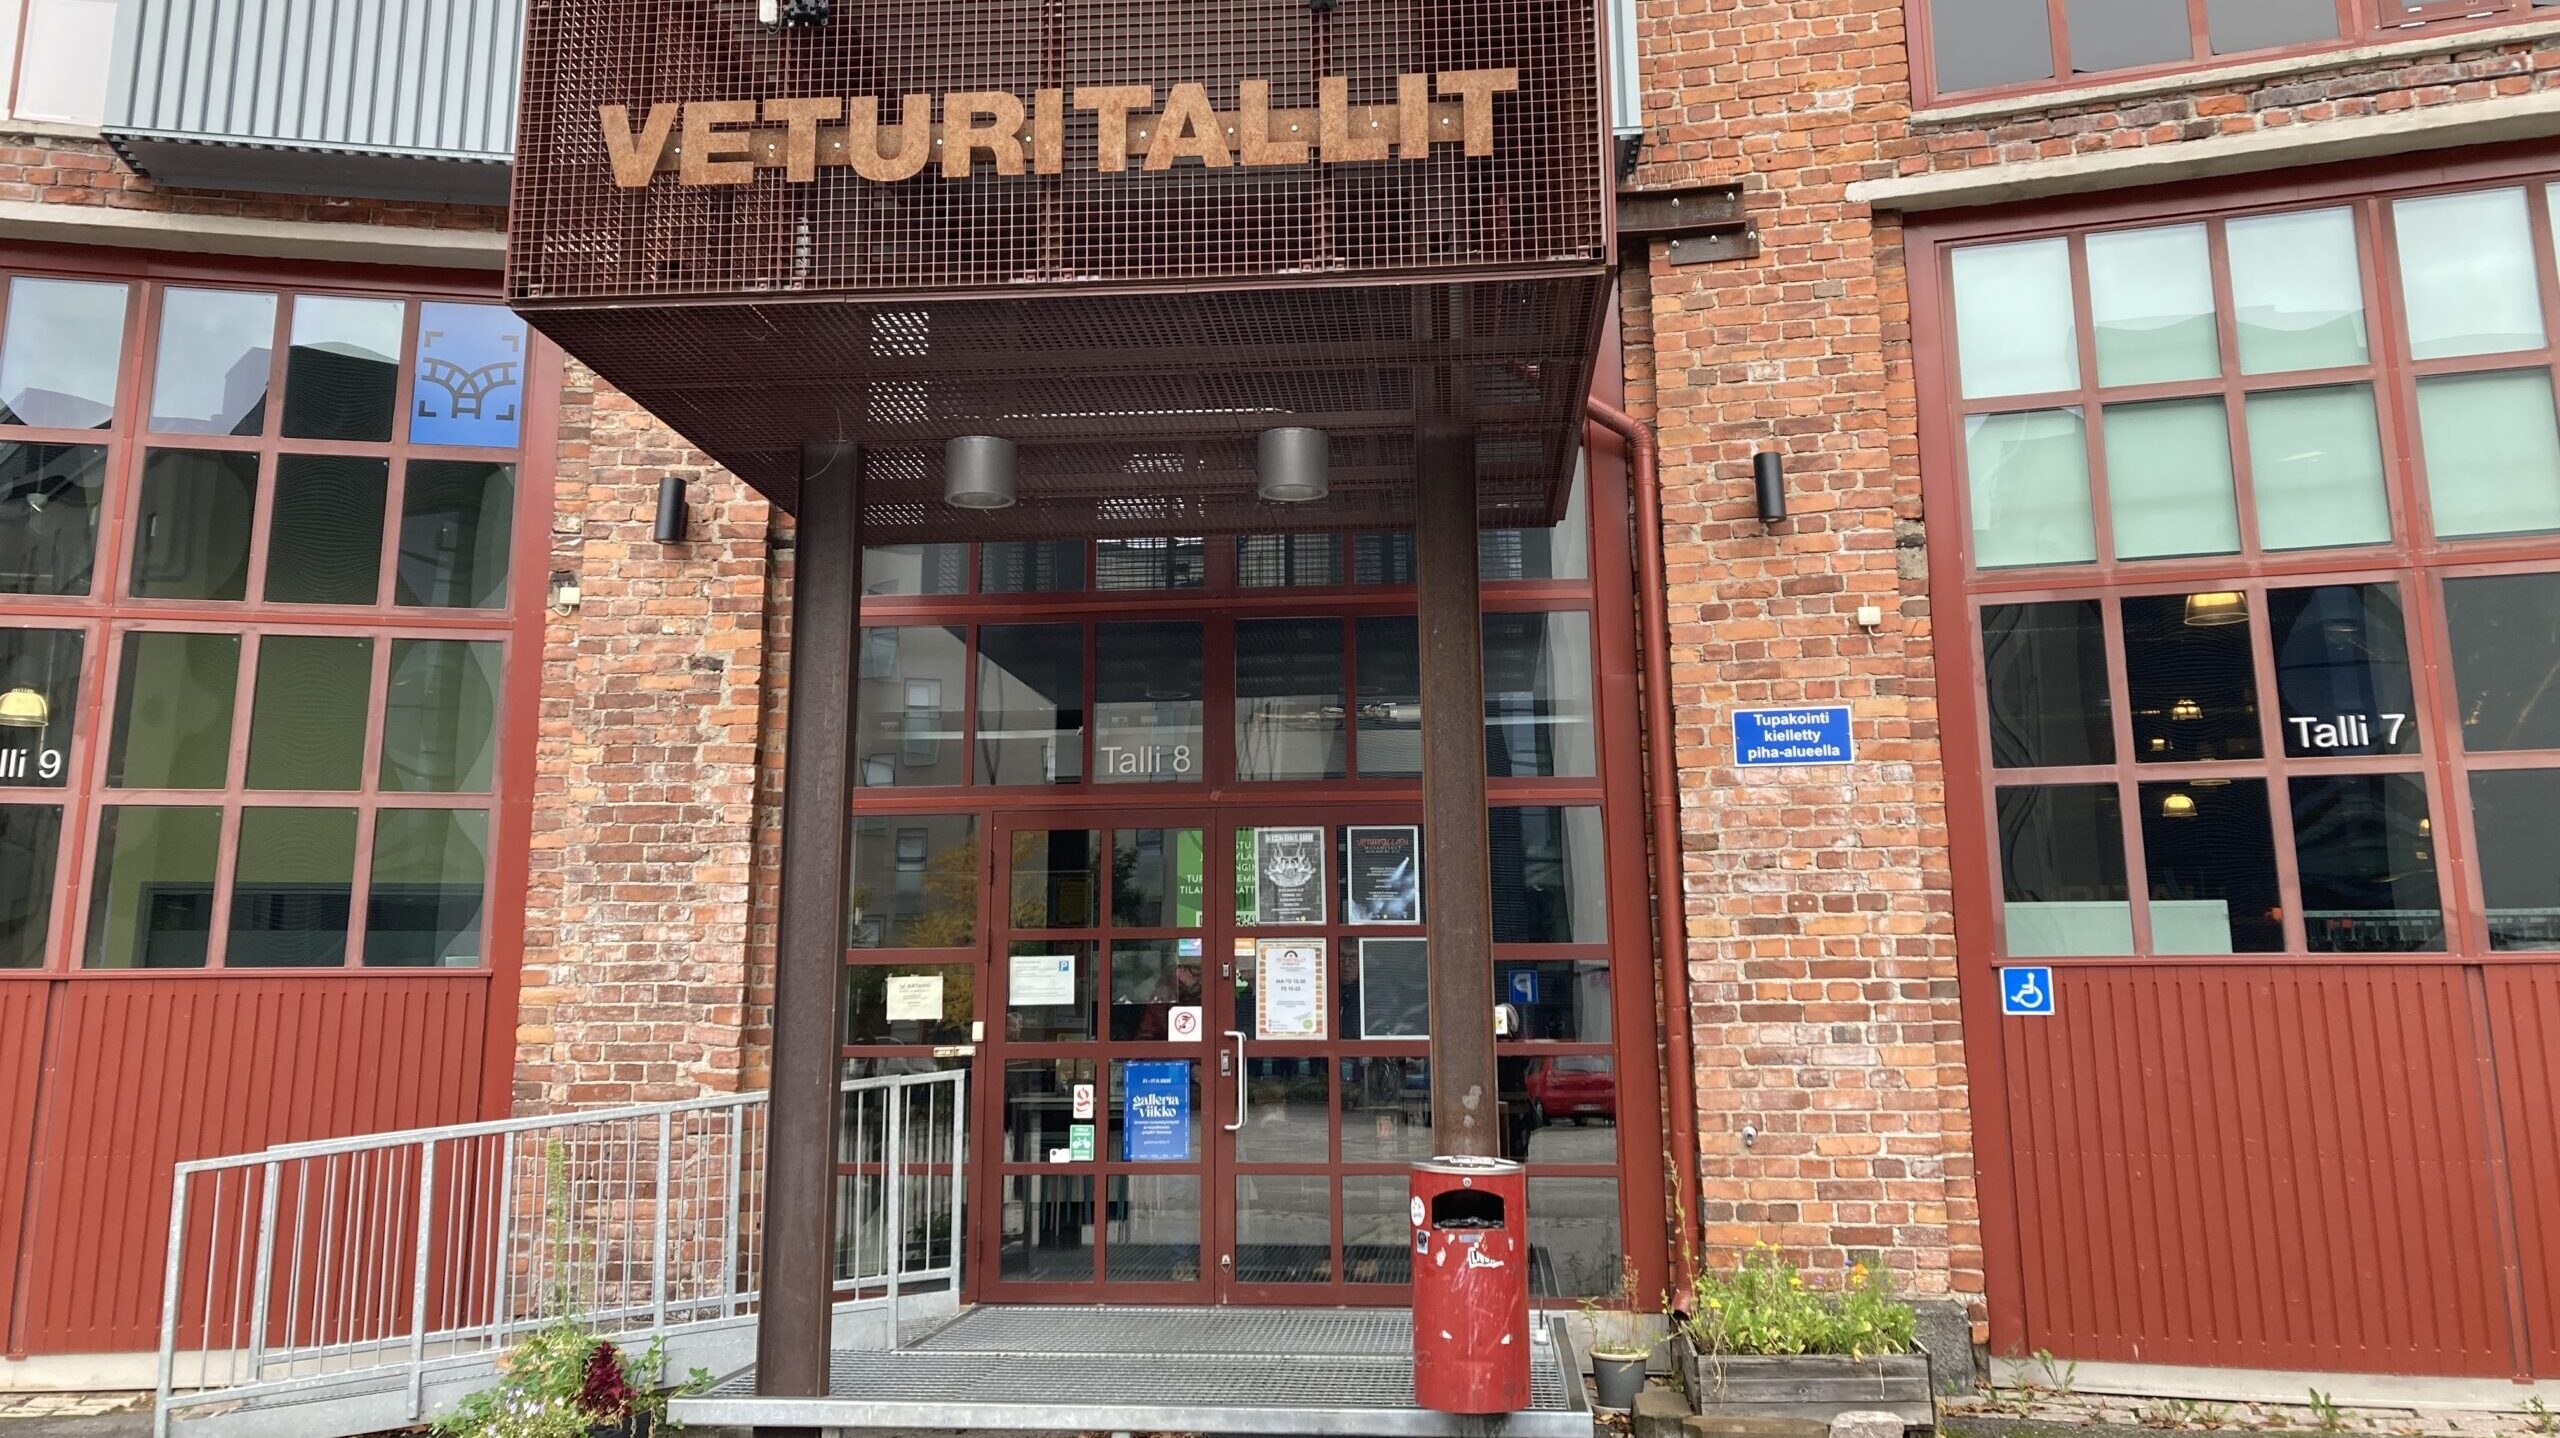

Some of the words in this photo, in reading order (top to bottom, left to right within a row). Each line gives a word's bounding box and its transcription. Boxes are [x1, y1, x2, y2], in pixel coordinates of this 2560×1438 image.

[597, 68, 1518, 188] VETURITALLIT
[1753, 711, 1829, 728] Tupakointi
[1764, 729, 1821, 743] kielletty
[2288, 714, 2370, 748] Talli
[2379, 713, 2406, 746] 7
[1100, 745, 1161, 774] Talli
[1173, 745, 1191, 773] 8
[1748, 745, 1840, 761] piha-alueella
[0, 748, 27, 778] lli
[38, 748, 61, 779] 9
[1132, 1093, 1180, 1110] galleria
[1139, 1105, 1177, 1118] viikko
